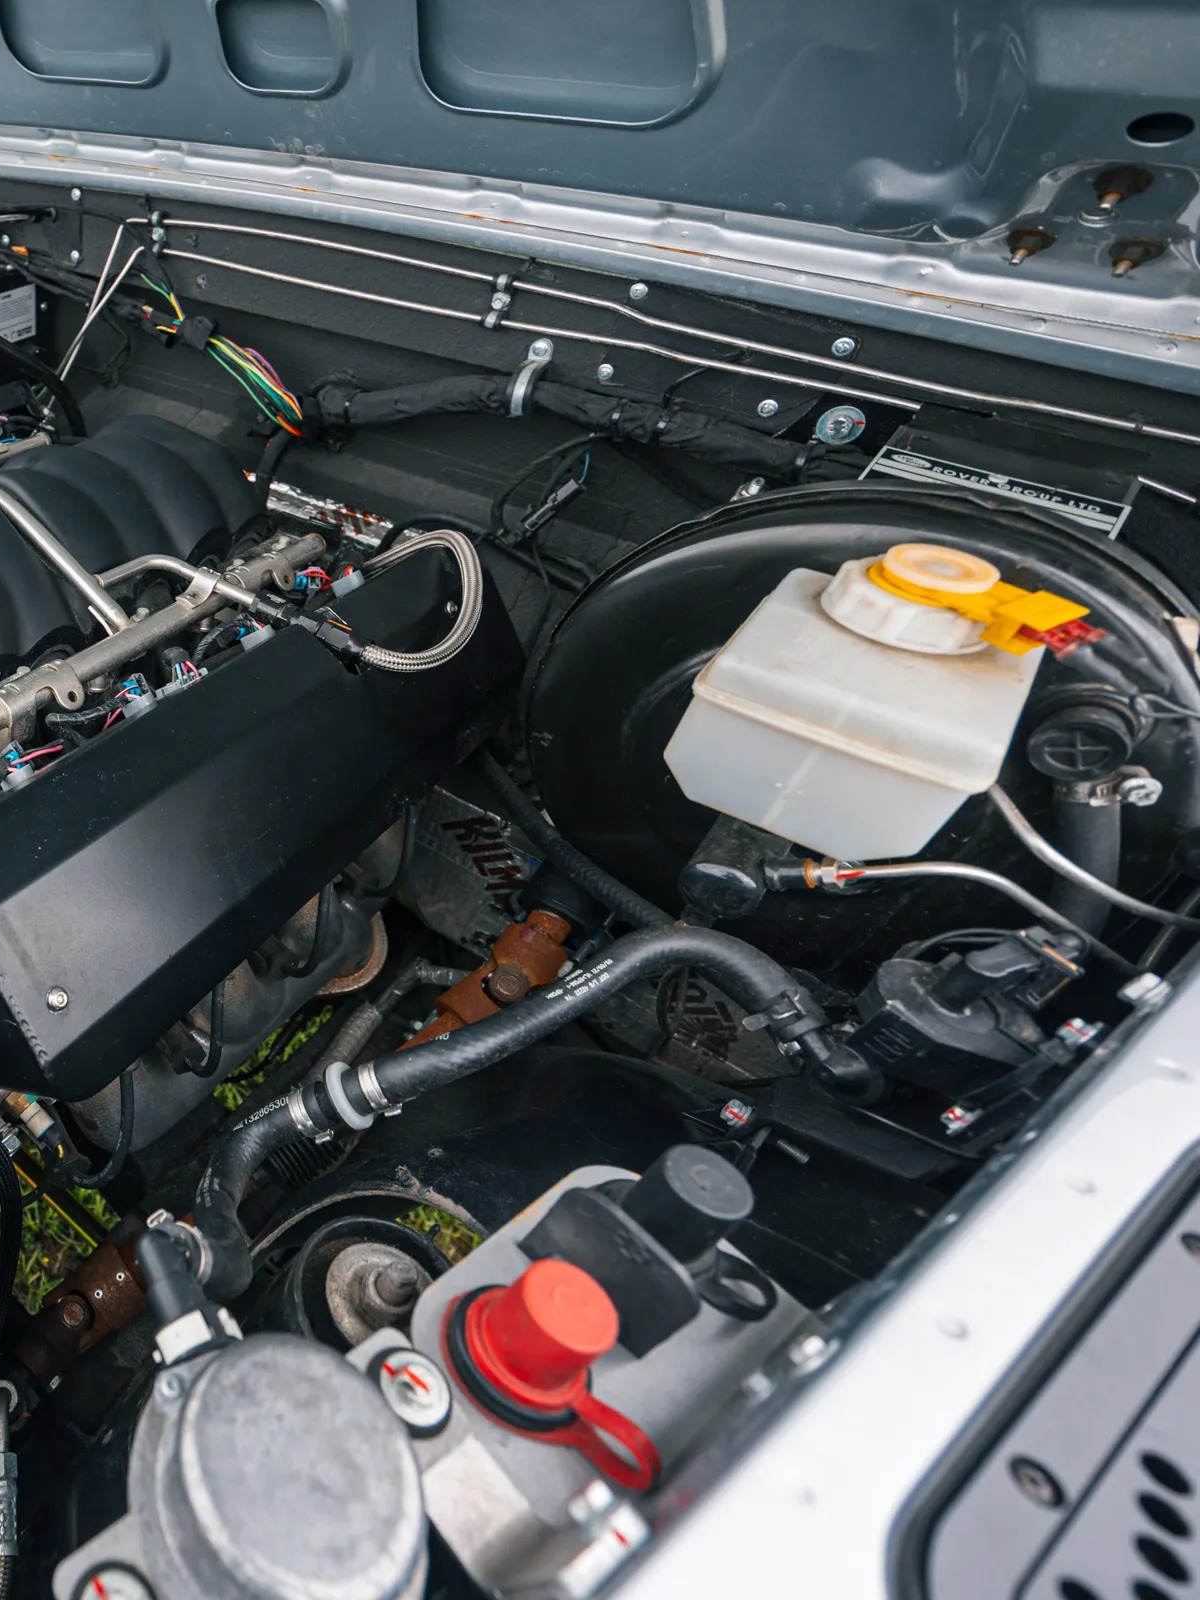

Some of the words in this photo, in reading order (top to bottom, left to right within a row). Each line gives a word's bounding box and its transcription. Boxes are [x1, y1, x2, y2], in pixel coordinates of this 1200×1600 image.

[932, 466, 990, 486] ROVER
[997, 482, 1062, 502] GROUP
[1068, 499, 1101, 513] LTD
